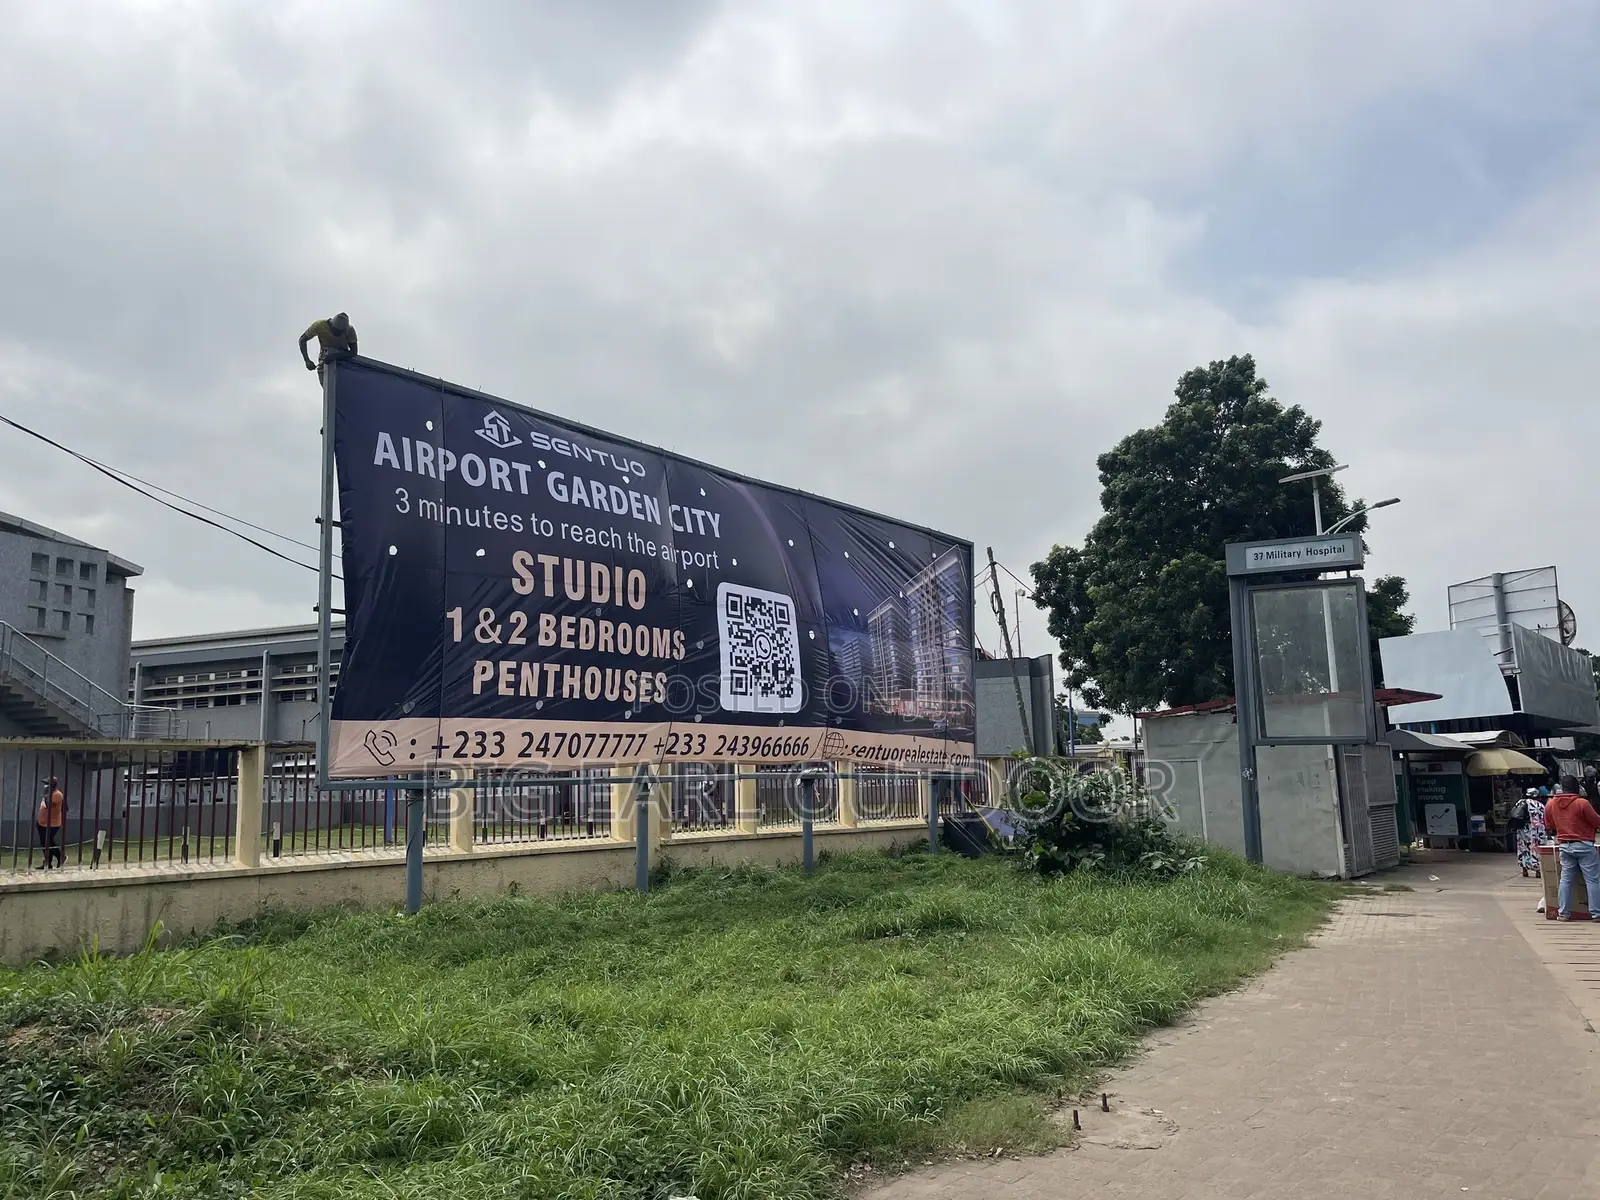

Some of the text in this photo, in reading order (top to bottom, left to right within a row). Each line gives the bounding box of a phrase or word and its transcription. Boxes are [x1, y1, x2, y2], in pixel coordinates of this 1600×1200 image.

[530, 431, 646, 477] SENTUO
[374, 431, 721, 538] AIRPORT GARDEN CITY
[395, 488, 719, 569] 3 minutes to reach the airport
[1253, 545, 1345, 560] 37 Military Hospital
[511, 550, 646, 611] STUDIO
[447, 607, 686, 661] 1 & 2 BEDROOMS
[473, 660, 667, 704] PENTHOUSES
[431, 731, 505, 758] +233
[518, 732, 648, 758] 247077777
[653, 732, 707, 756] +233
[713, 735, 810, 757] 243966666
